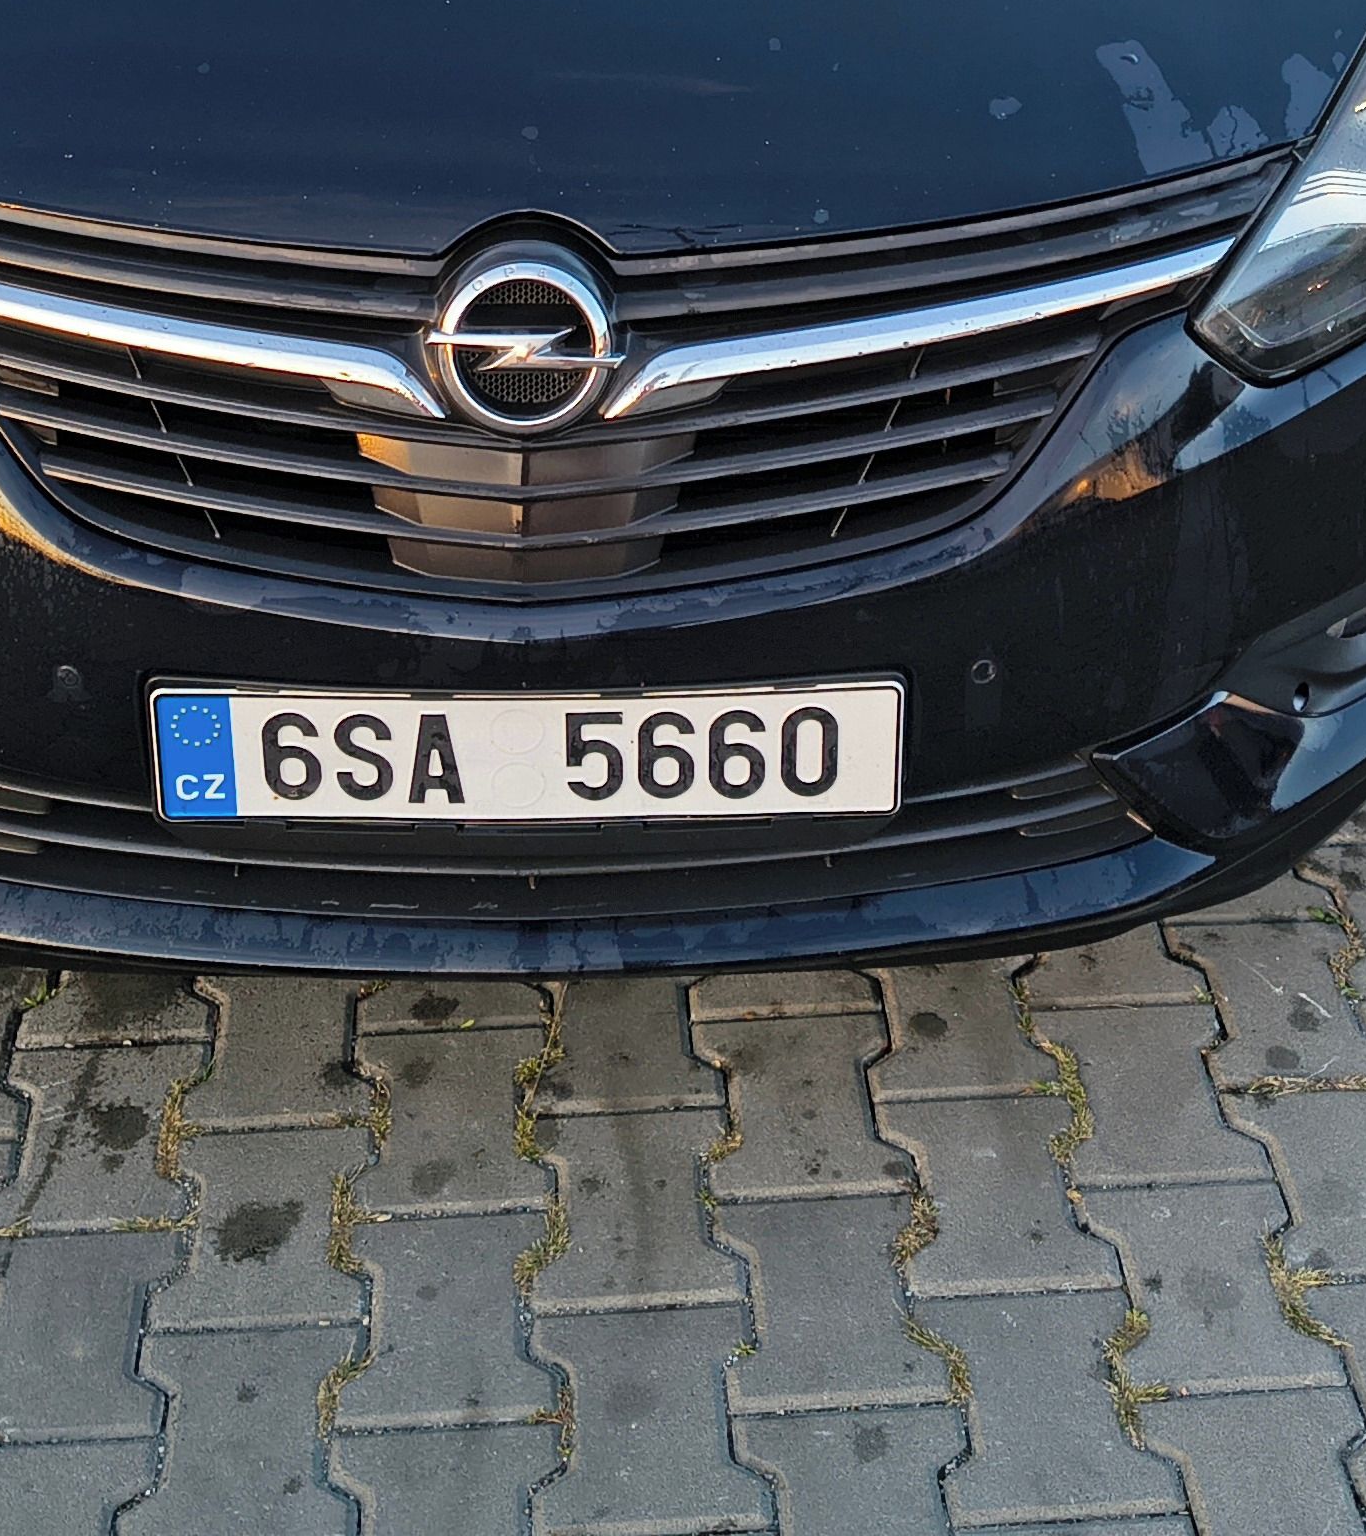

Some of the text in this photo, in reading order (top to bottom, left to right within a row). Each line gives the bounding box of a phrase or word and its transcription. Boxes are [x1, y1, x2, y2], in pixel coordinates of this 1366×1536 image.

[471, 266, 577, 292] OPEL
[261, 705, 840, 805] 6SA 5660
[175, 772, 227, 801] CZ
